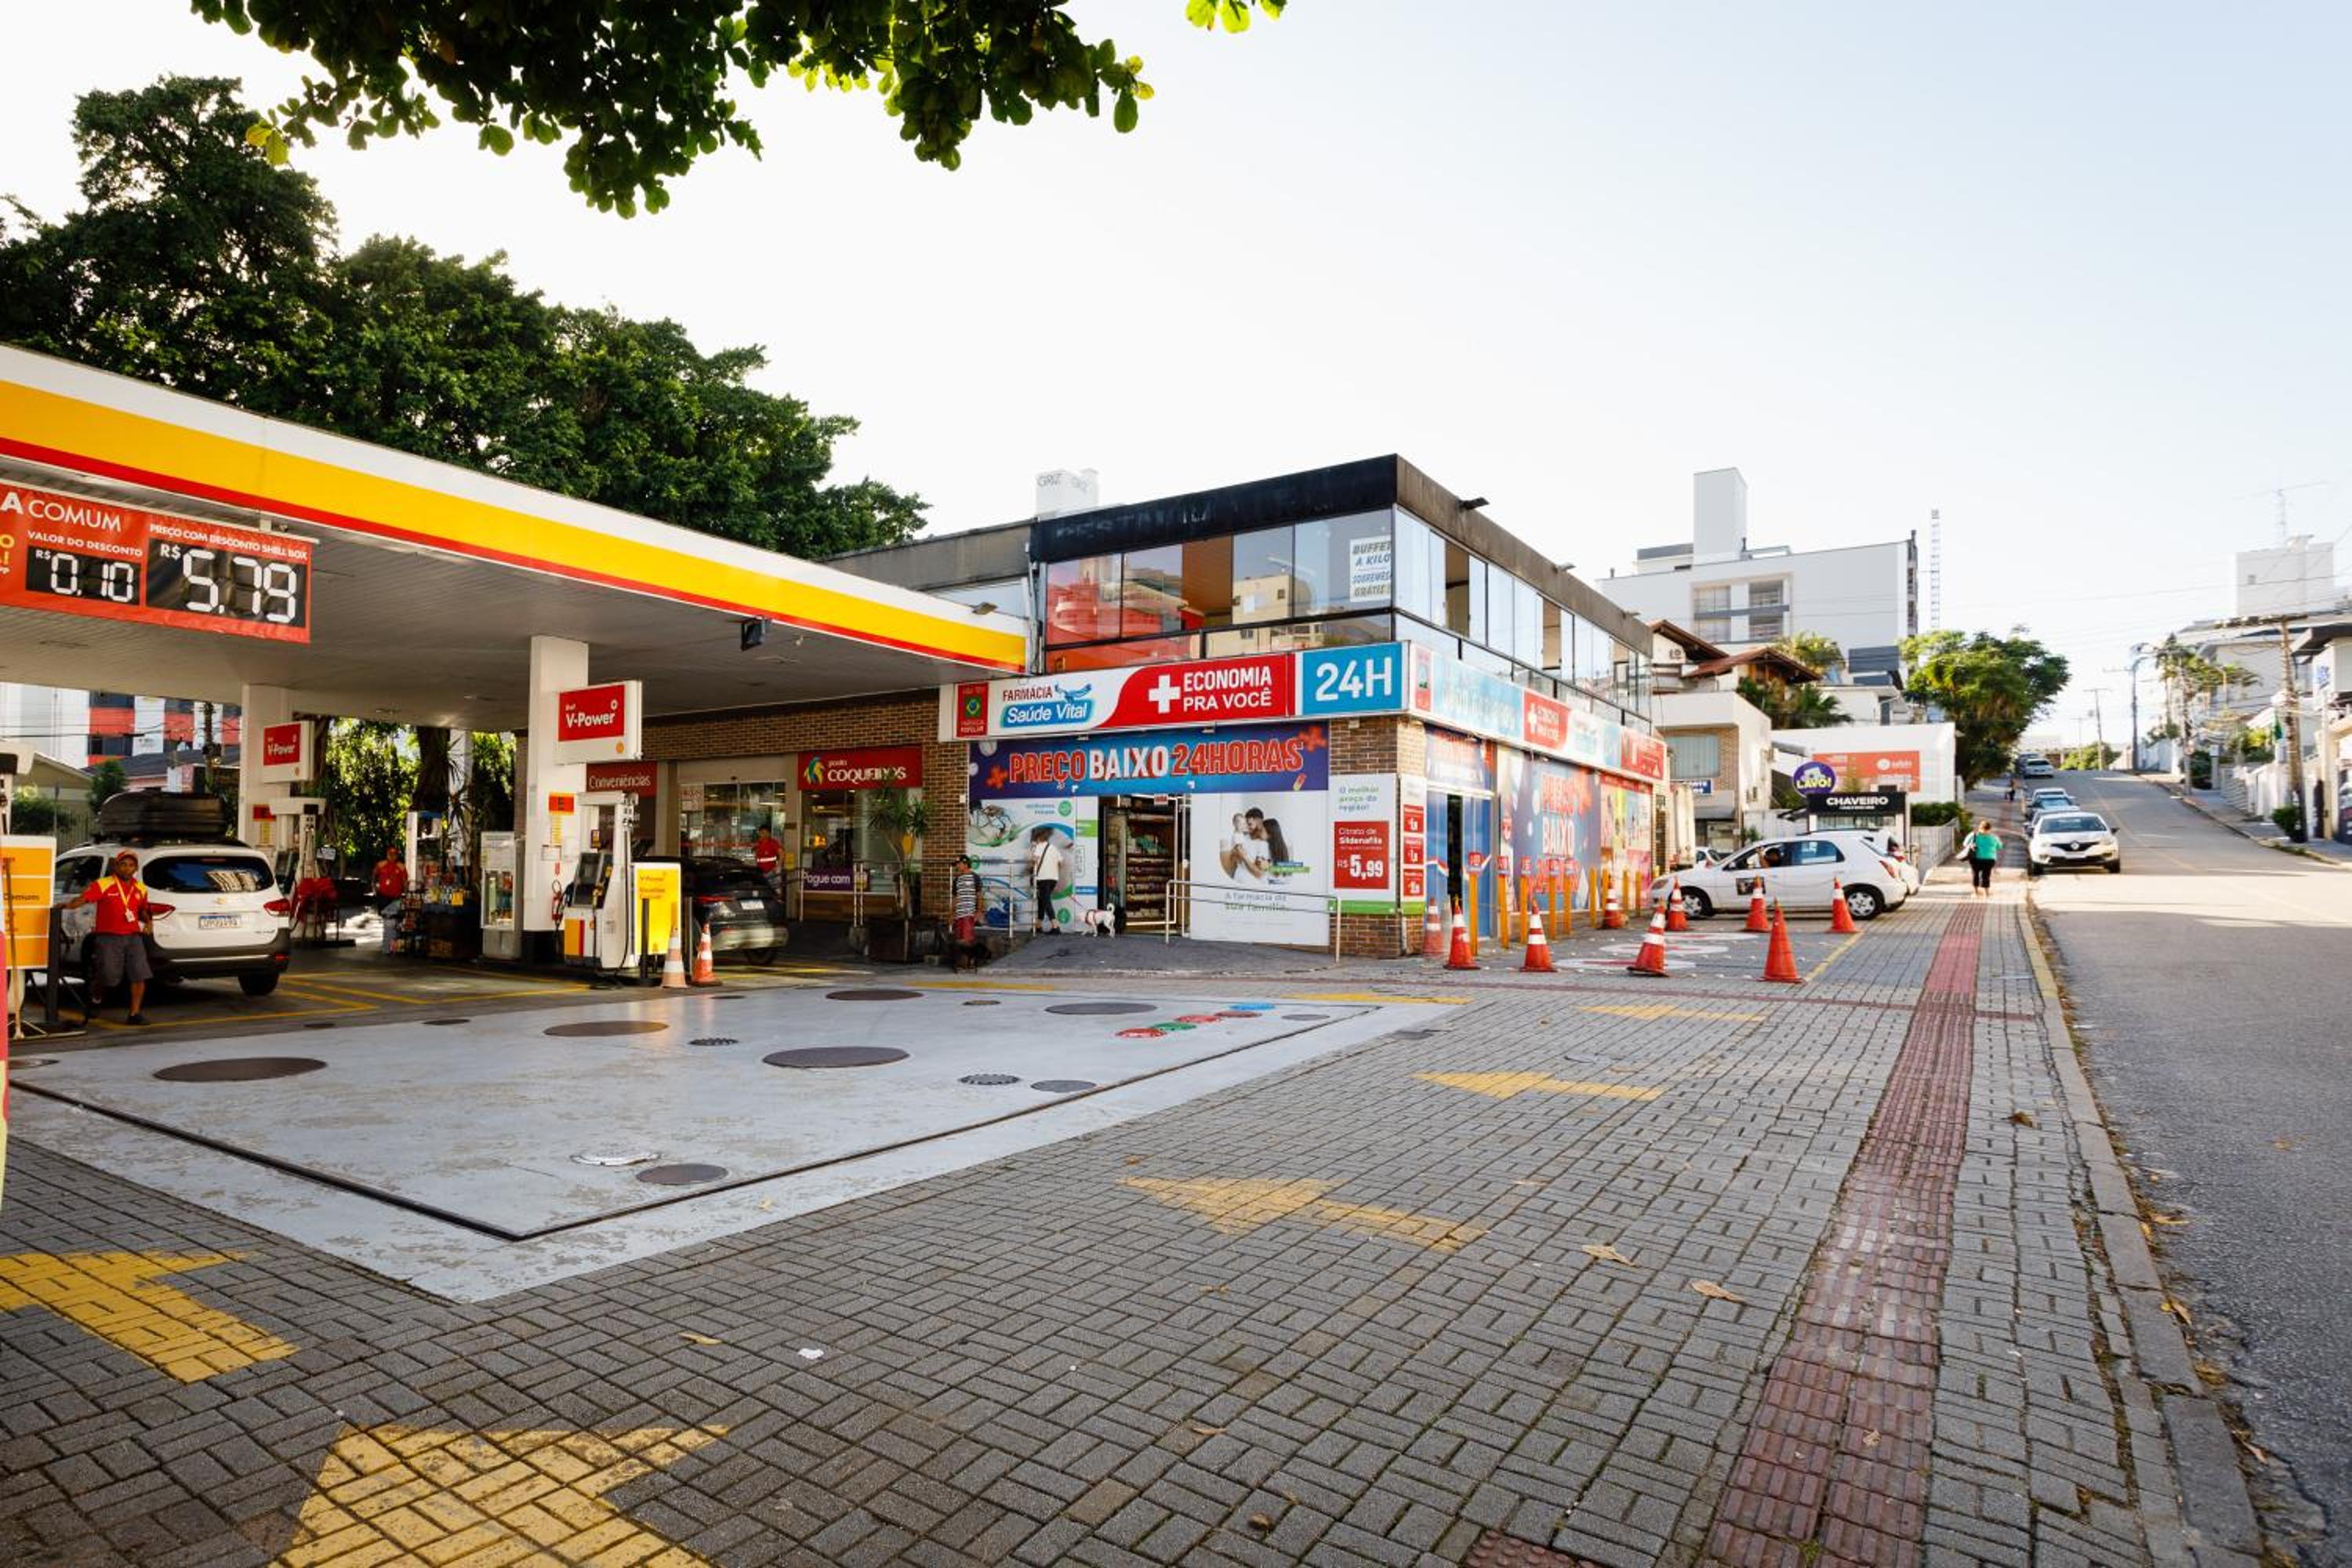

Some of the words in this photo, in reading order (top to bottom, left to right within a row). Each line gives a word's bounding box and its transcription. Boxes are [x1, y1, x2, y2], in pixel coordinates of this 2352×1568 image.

[28, 499, 122, 532] COMUM
[27, 530, 64, 543] VALOR
[67, 538, 85, 548] DO
[87, 540, 143, 557] DESCONTO
[150, 523, 182, 539] PREÇO
[183, 529, 208, 542] COM
[209, 535, 260, 552] DESCONTO
[262, 544, 286, 556] SHELL
[288, 550, 308, 561] BOX
[160, 543, 181, 561] R$
[35, 550, 51, 561] R$
[1367, 553, 1391, 564] KILO
[1182, 666, 1272, 692] ECONOMIA
[1315, 656, 1393, 702] 24H
[1182, 695, 1219, 711] PRA
[1225, 689, 1272, 709] VOCÊ
[565, 711, 615, 728] V-Power
[1007, 706, 1052, 724] Saúde
[1056, 702, 1087, 720] Vital
[827, 766, 907, 784] COQUEIS
[1009, 749, 1087, 790] PREÇO
[1089, 746, 1170, 781] BAIXO
[1796, 777, 1832, 789] LAVO!
[1826, 796, 1889, 806] CHAVEIRO
[1350, 854, 1384, 880] 5,99
